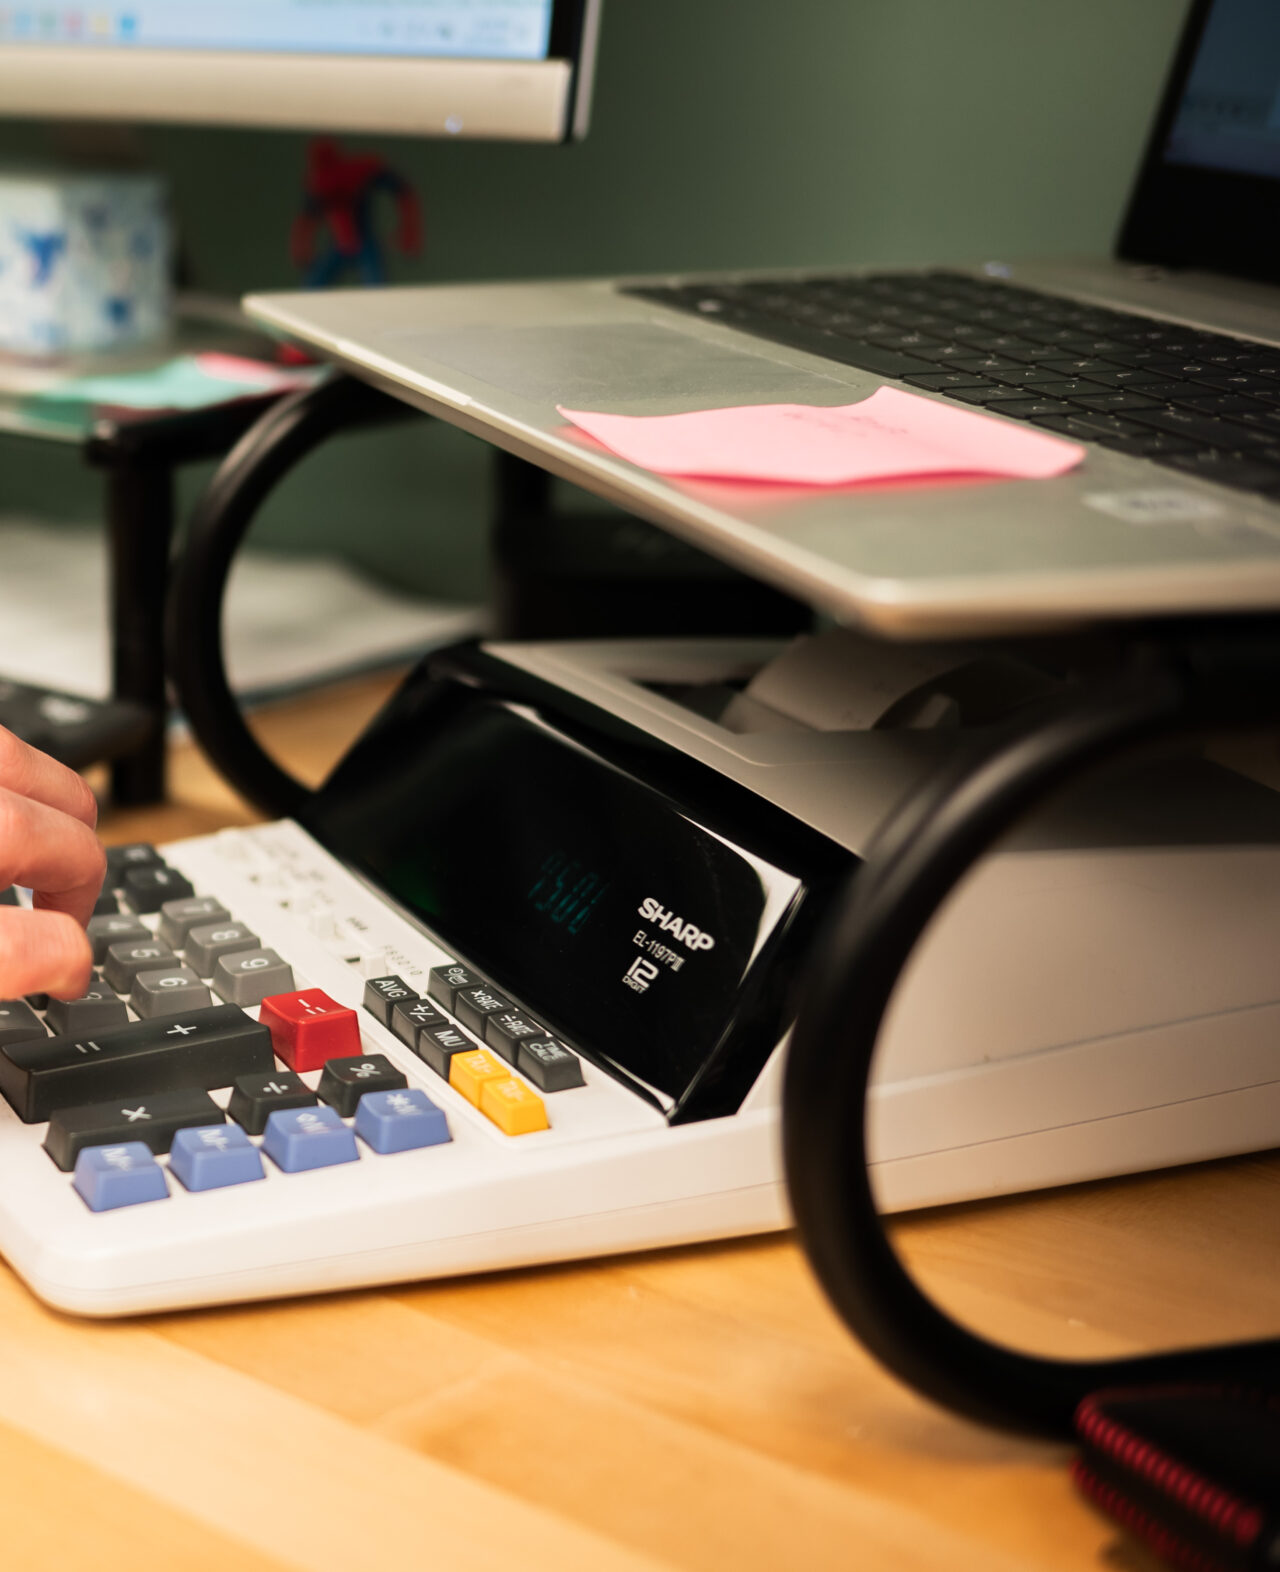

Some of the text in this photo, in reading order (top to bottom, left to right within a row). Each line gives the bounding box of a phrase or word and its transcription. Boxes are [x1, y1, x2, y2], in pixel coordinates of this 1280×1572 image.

[637, 897, 716, 951] SHARP
[211, 929, 240, 942] 8
[240, 957, 270, 970] 9
[158, 976, 189, 988] 6
[374, 979, 408, 999] AVG
[433, 1029, 467, 1048] MU
